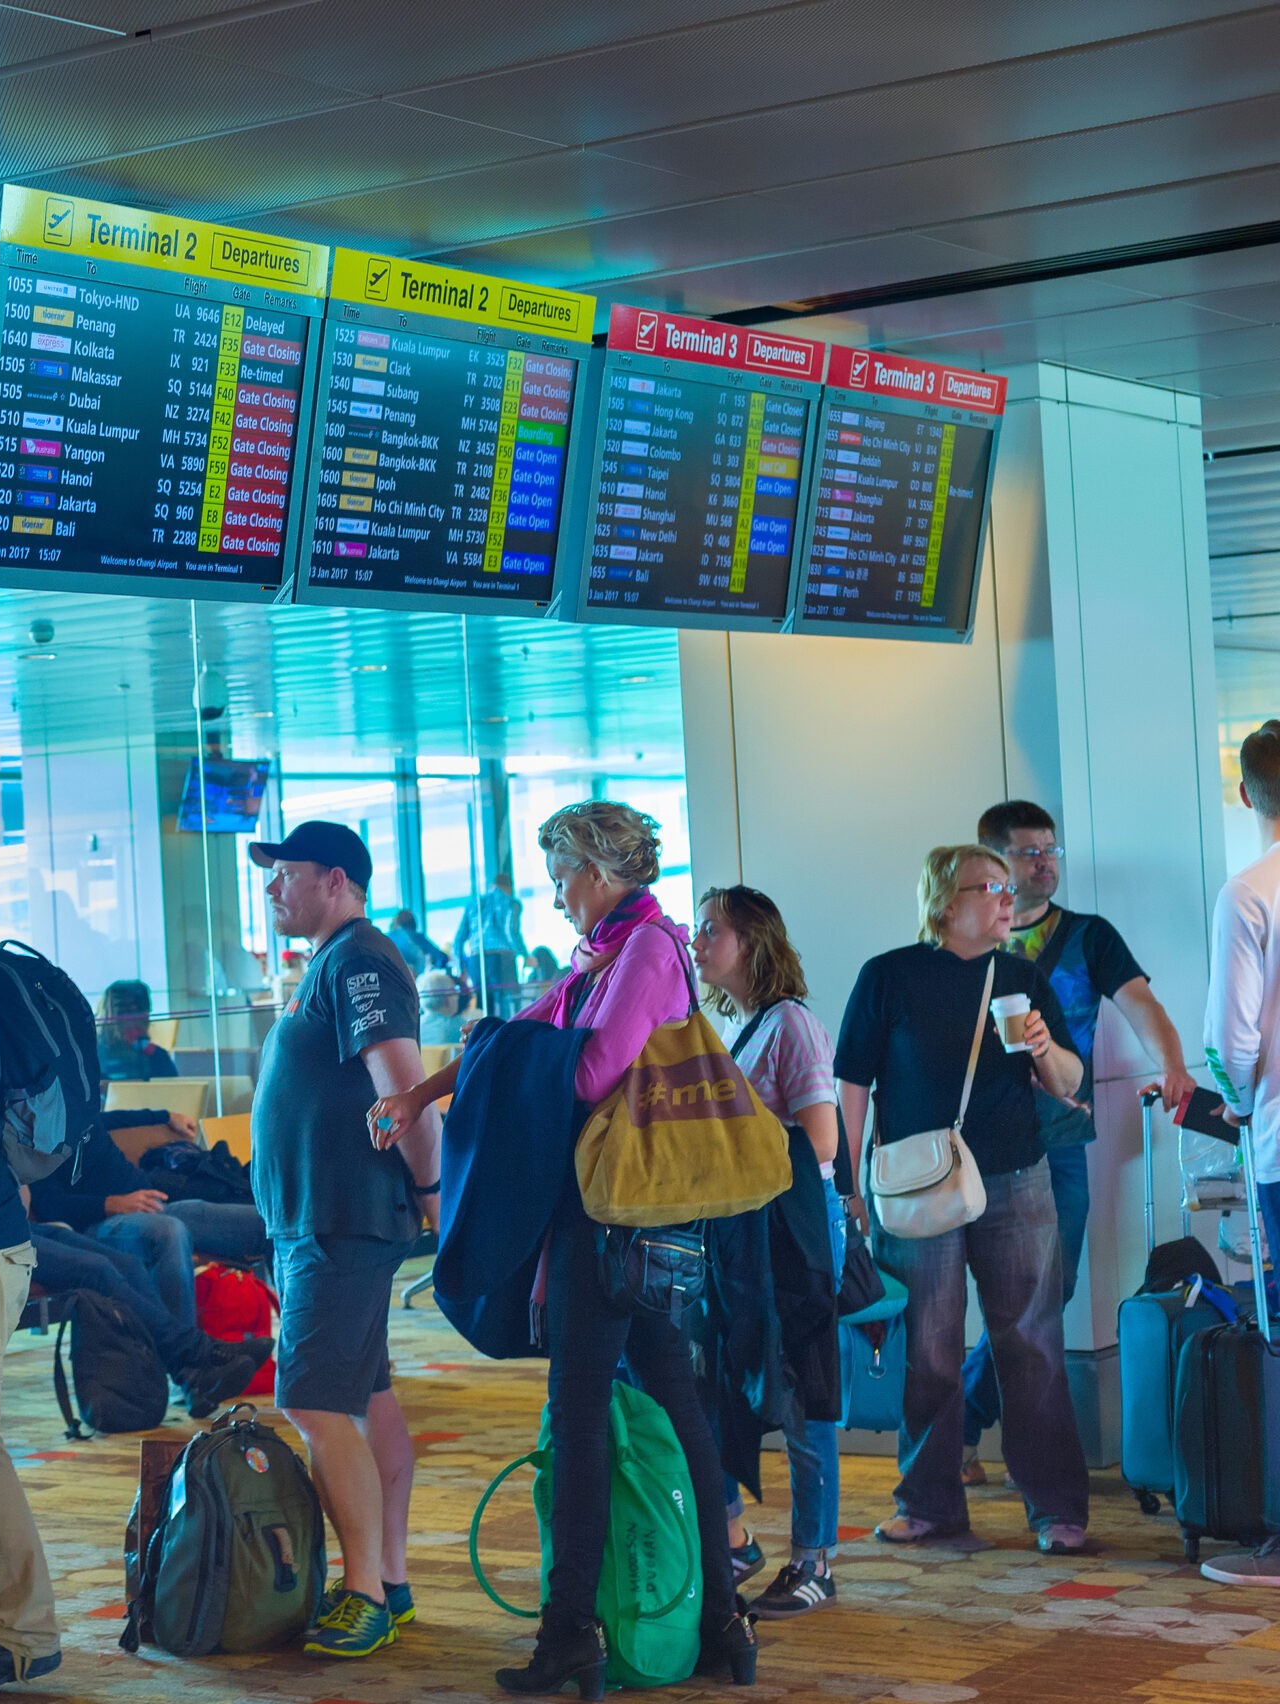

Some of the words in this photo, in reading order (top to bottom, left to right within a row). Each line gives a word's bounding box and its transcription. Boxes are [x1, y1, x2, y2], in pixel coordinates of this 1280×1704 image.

[87, 213, 179, 257] Terminal
[184, 232, 197, 261] 2
[221, 240, 299, 273] Departures
[16, 248, 37, 264] Time
[86, 261, 96, 275] To
[184, 277, 207, 295] Flight
[232, 286, 250, 301] Gate
[264, 291, 296, 309] Remarks
[400, 271, 474, 309] Terminal
[477, 286, 488, 312] 2
[508, 293, 571, 321] Departures
[7, 276, 32, 293] 1055
[79, 288, 139, 311] Tokyo-HND
[175, 303, 190, 319] UA
[196, 306, 219, 323] 9646
[224, 312, 241, 327] E12
[245, 315, 284, 336] Delayed
[664, 322, 726, 356] Terminal
[728, 334, 738, 358] 3
[752, 339, 805, 365] Departures
[874, 361, 925, 392] Terminal
[926, 371, 935, 394] 3
[946, 376, 991, 399] Departures
[317, 493, 337, 507] 1605
[373, 499, 386, 513] Ho
[388, 500, 402, 514] Chi
[404, 502, 425, 516] Minh
[428, 504, 445, 522] City
[451, 505, 461, 519] TR
[468, 507, 488, 522] 2328
[490, 511, 505, 524] F37
[508, 513, 526, 525] Gate
[528, 515, 549, 528] Open
[55, 521, 75, 537] Bali
[152, 528, 164, 543] TR
[172, 530, 197, 545] 2288
[200, 533, 218, 548] F59
[222, 534, 244, 550] Gate
[246, 536, 280, 556] Closing
[351, 1009, 387, 1036] ZEST
